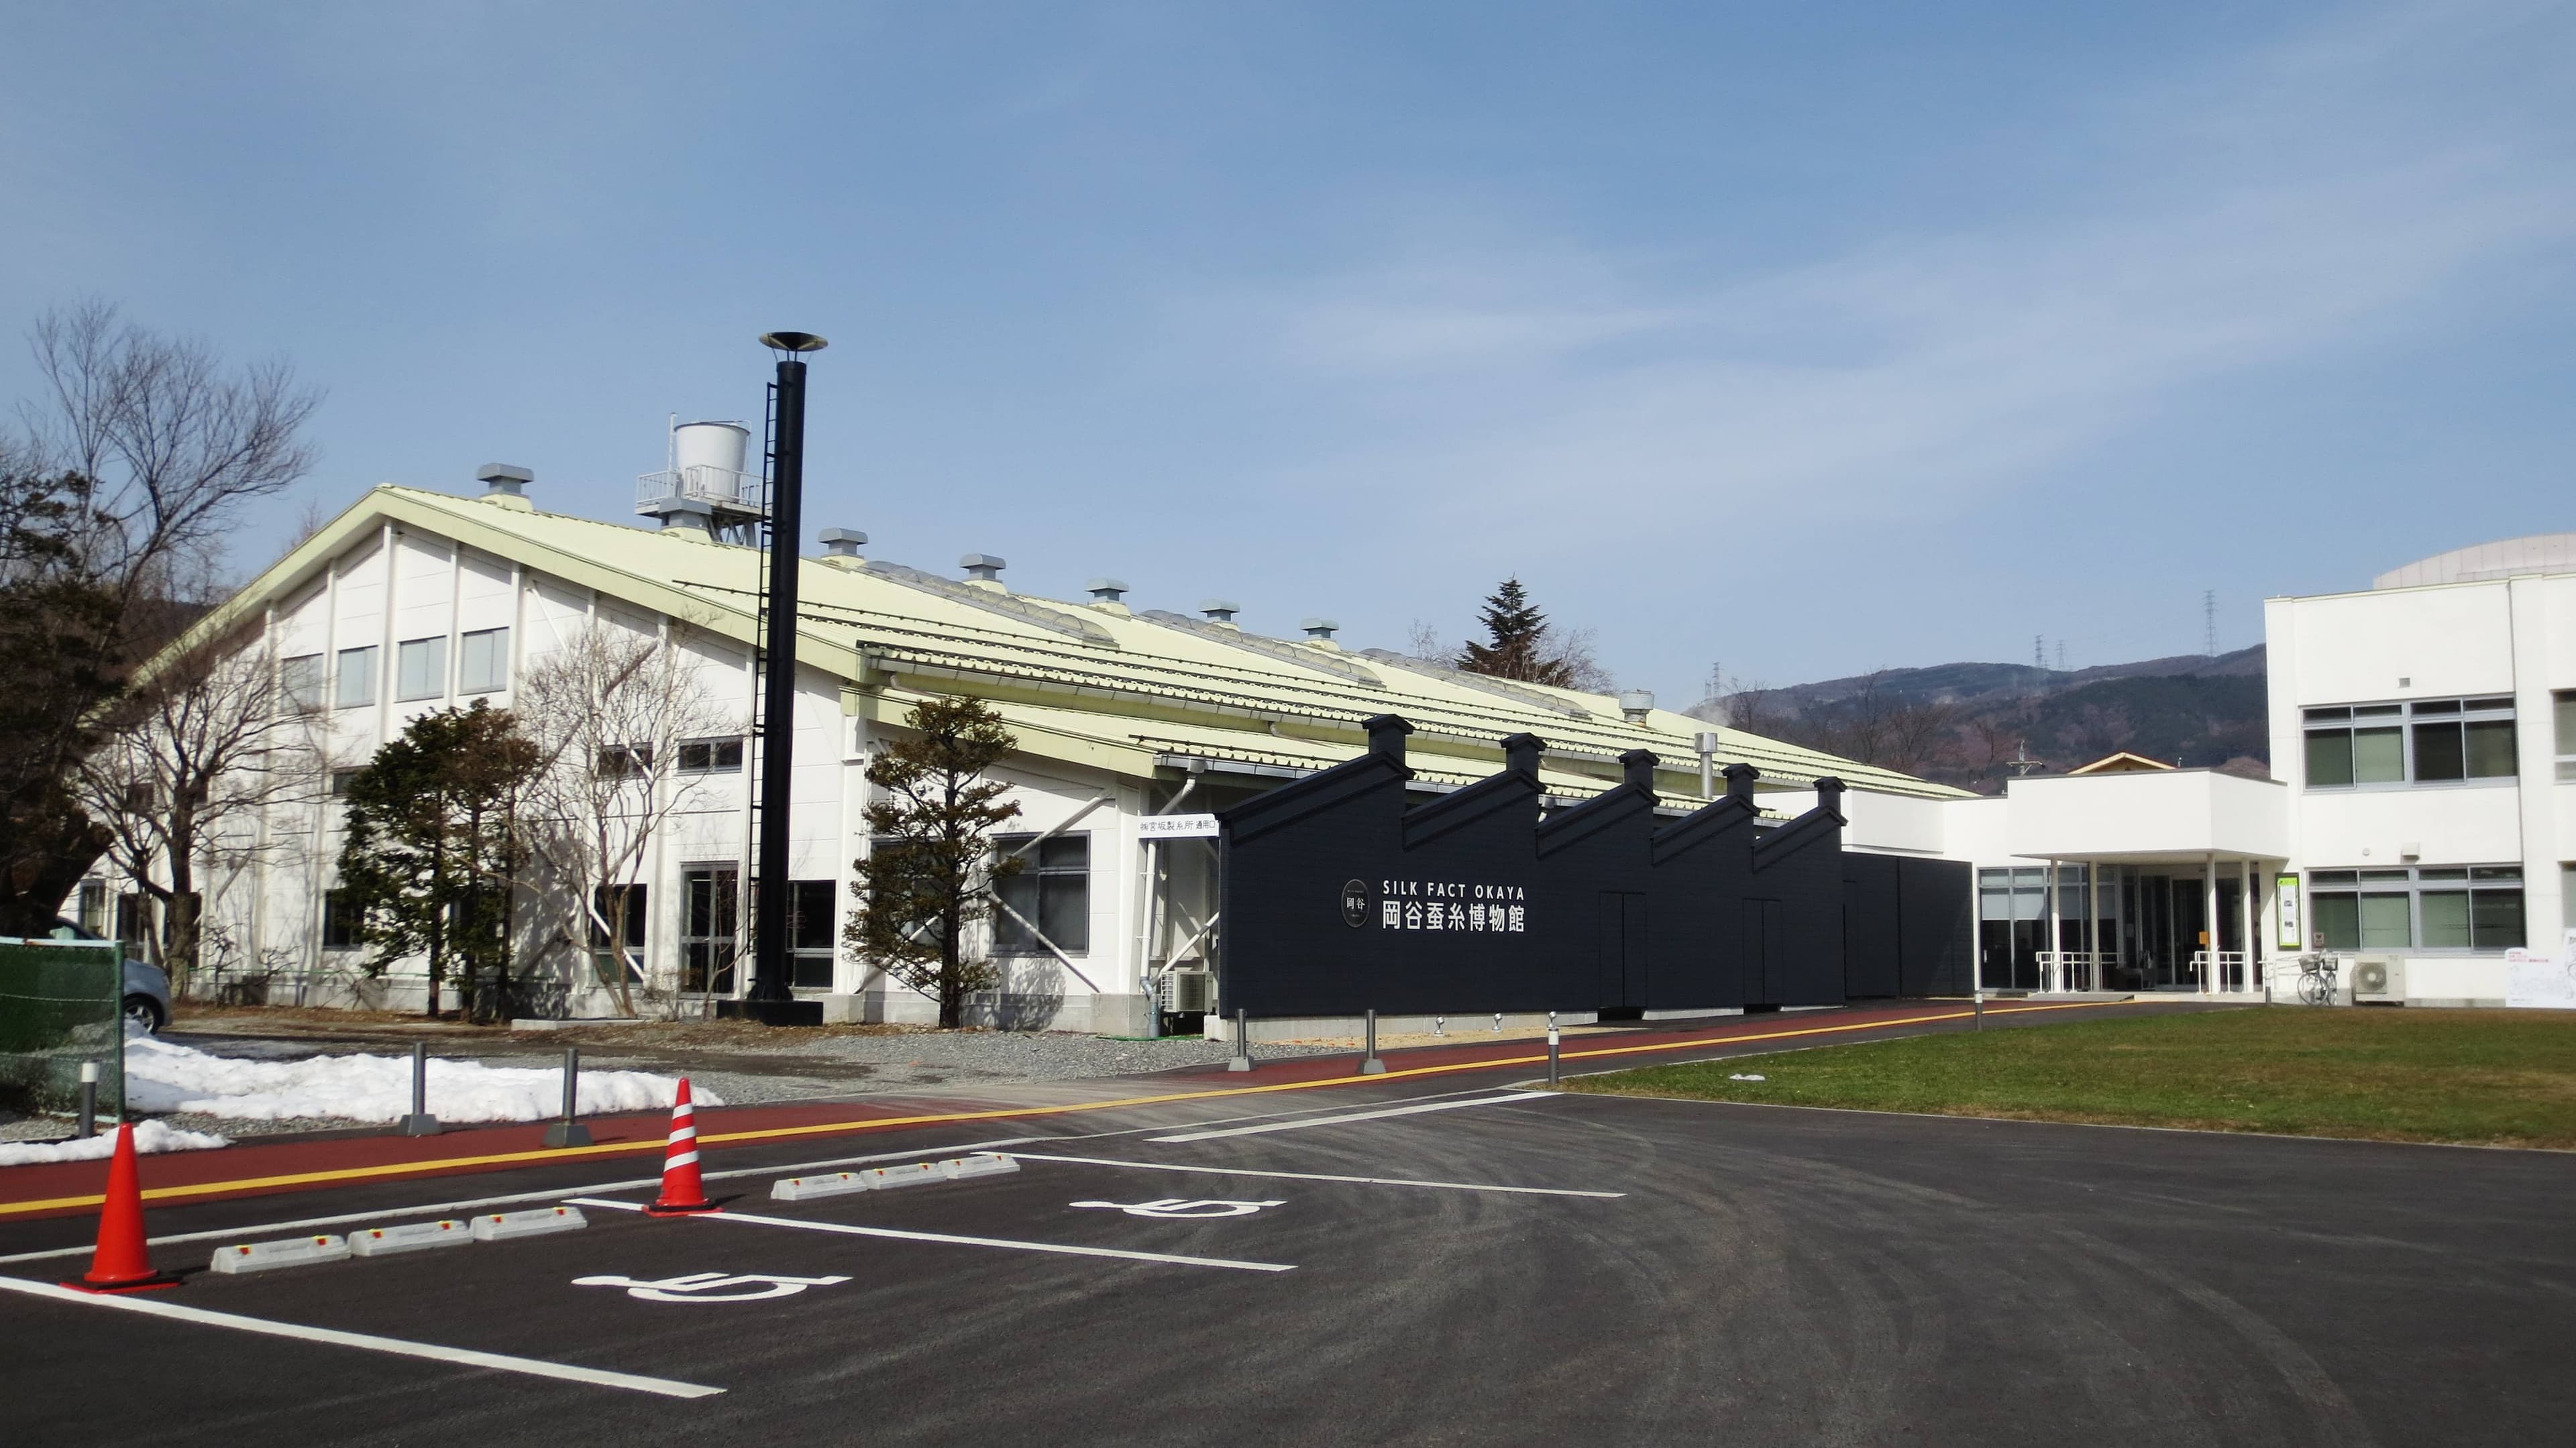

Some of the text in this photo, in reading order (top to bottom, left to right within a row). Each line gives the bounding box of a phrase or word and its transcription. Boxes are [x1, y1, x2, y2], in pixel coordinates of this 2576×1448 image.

[1383, 880, 1524, 900] SILK FACT OKAYA
[1346, 897, 1365, 910] 岡谷
[1383, 900, 1525, 932] 岡谷蚕糸博物館
